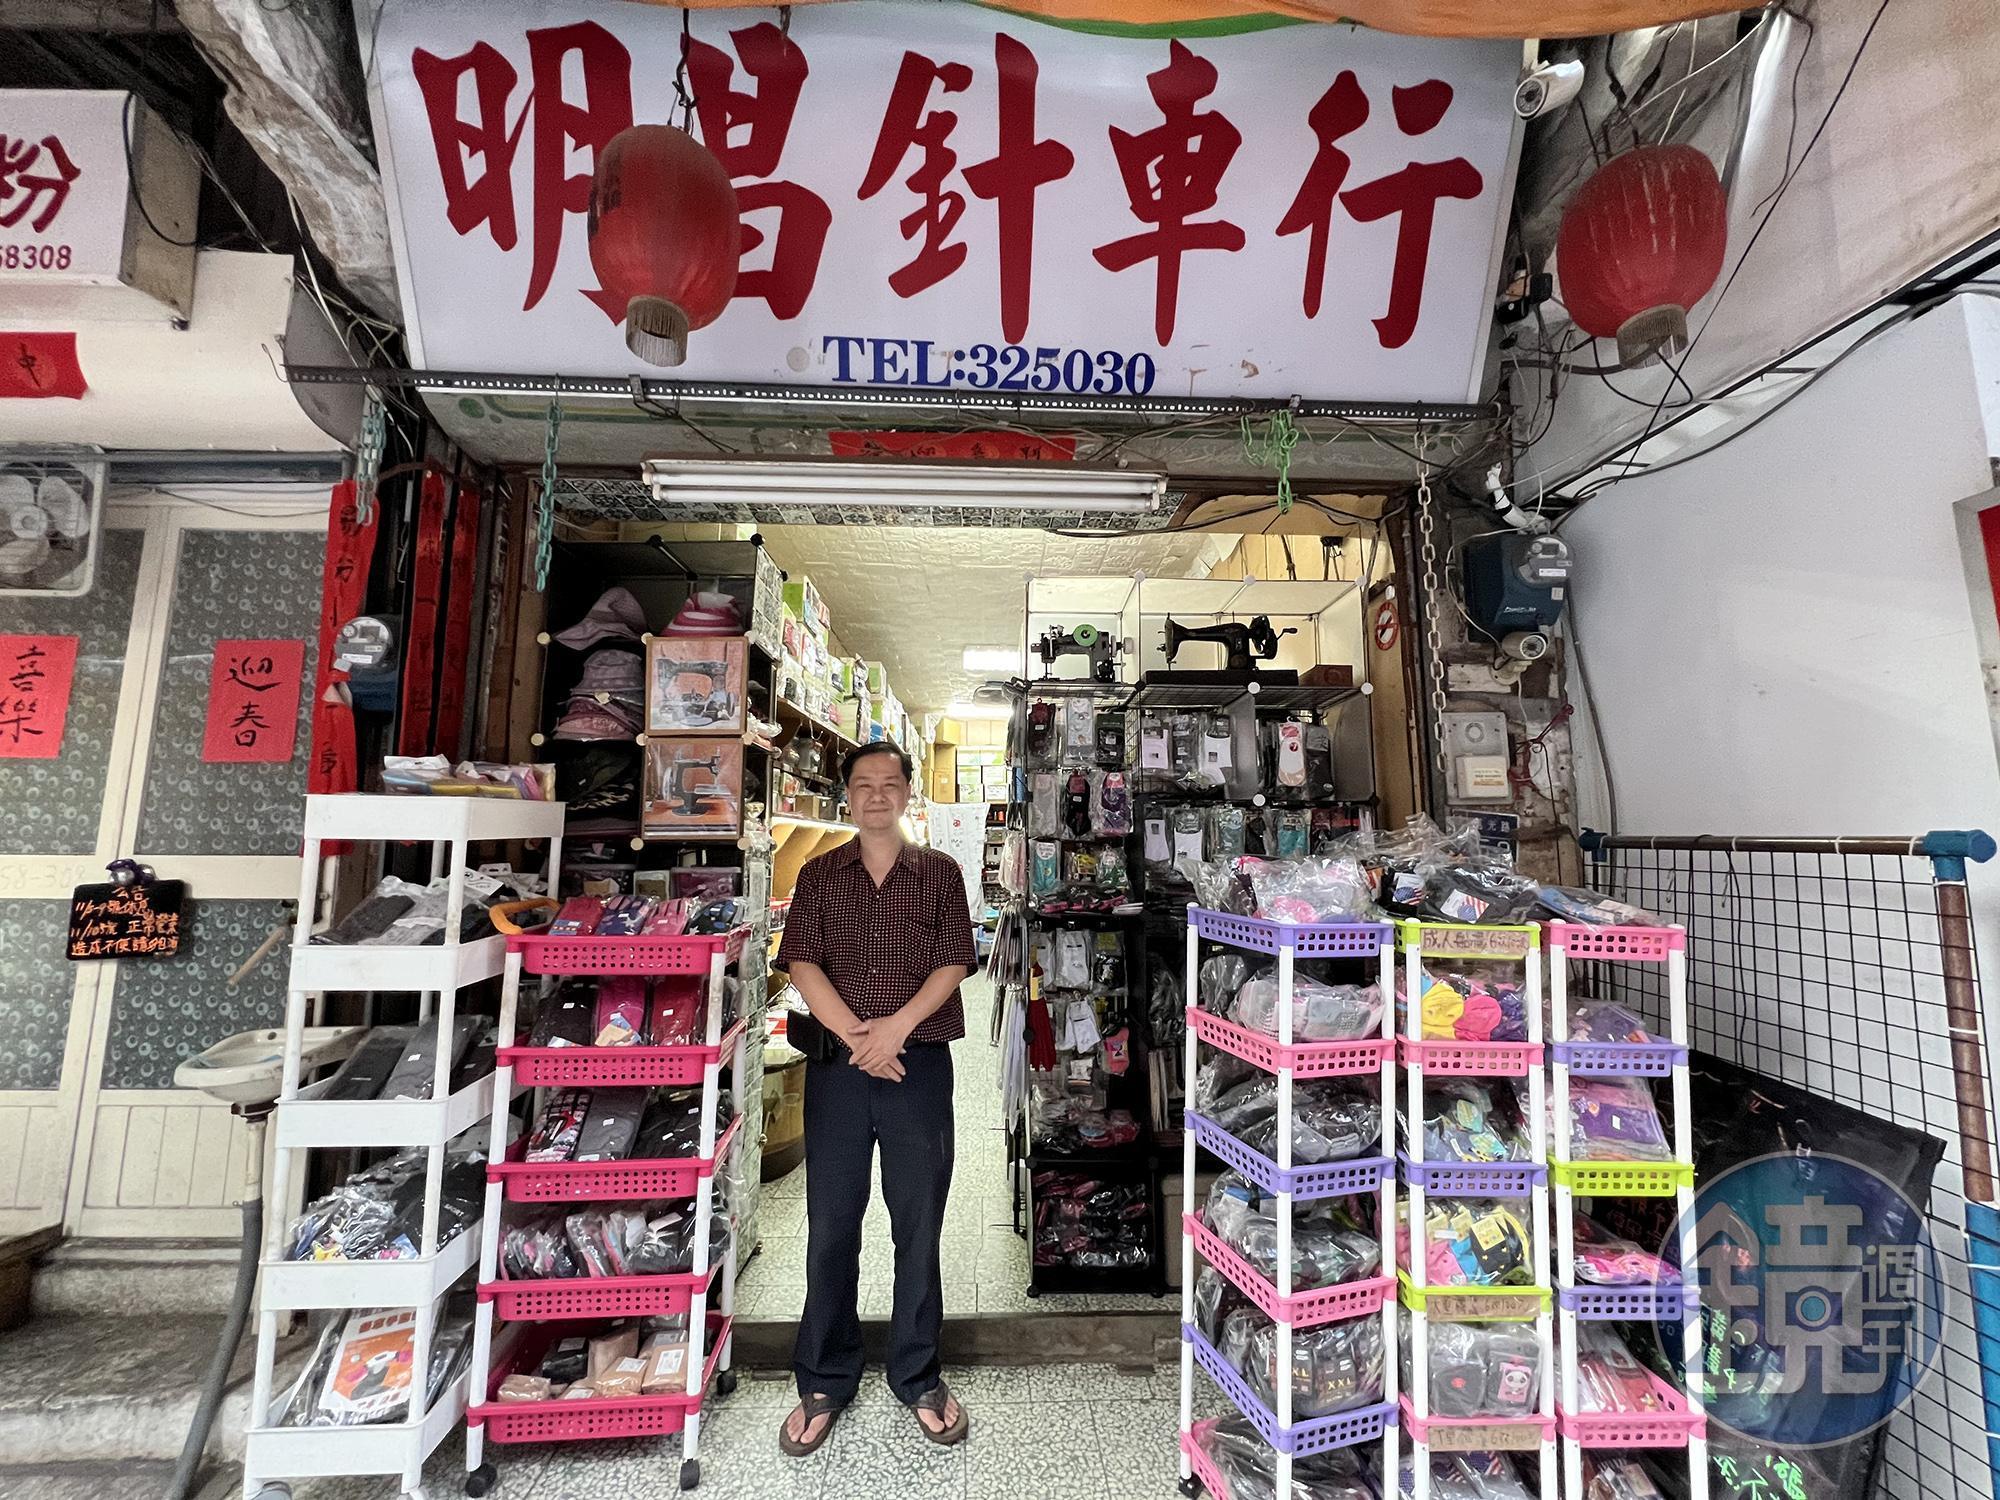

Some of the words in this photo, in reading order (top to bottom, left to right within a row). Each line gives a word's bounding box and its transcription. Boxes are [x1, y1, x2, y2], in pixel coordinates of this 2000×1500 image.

[411, 20, 1483, 350] 明昌針車行
[0, 245, 72, 270] 8308
[822, 336, 1156, 396] TEL:325030
